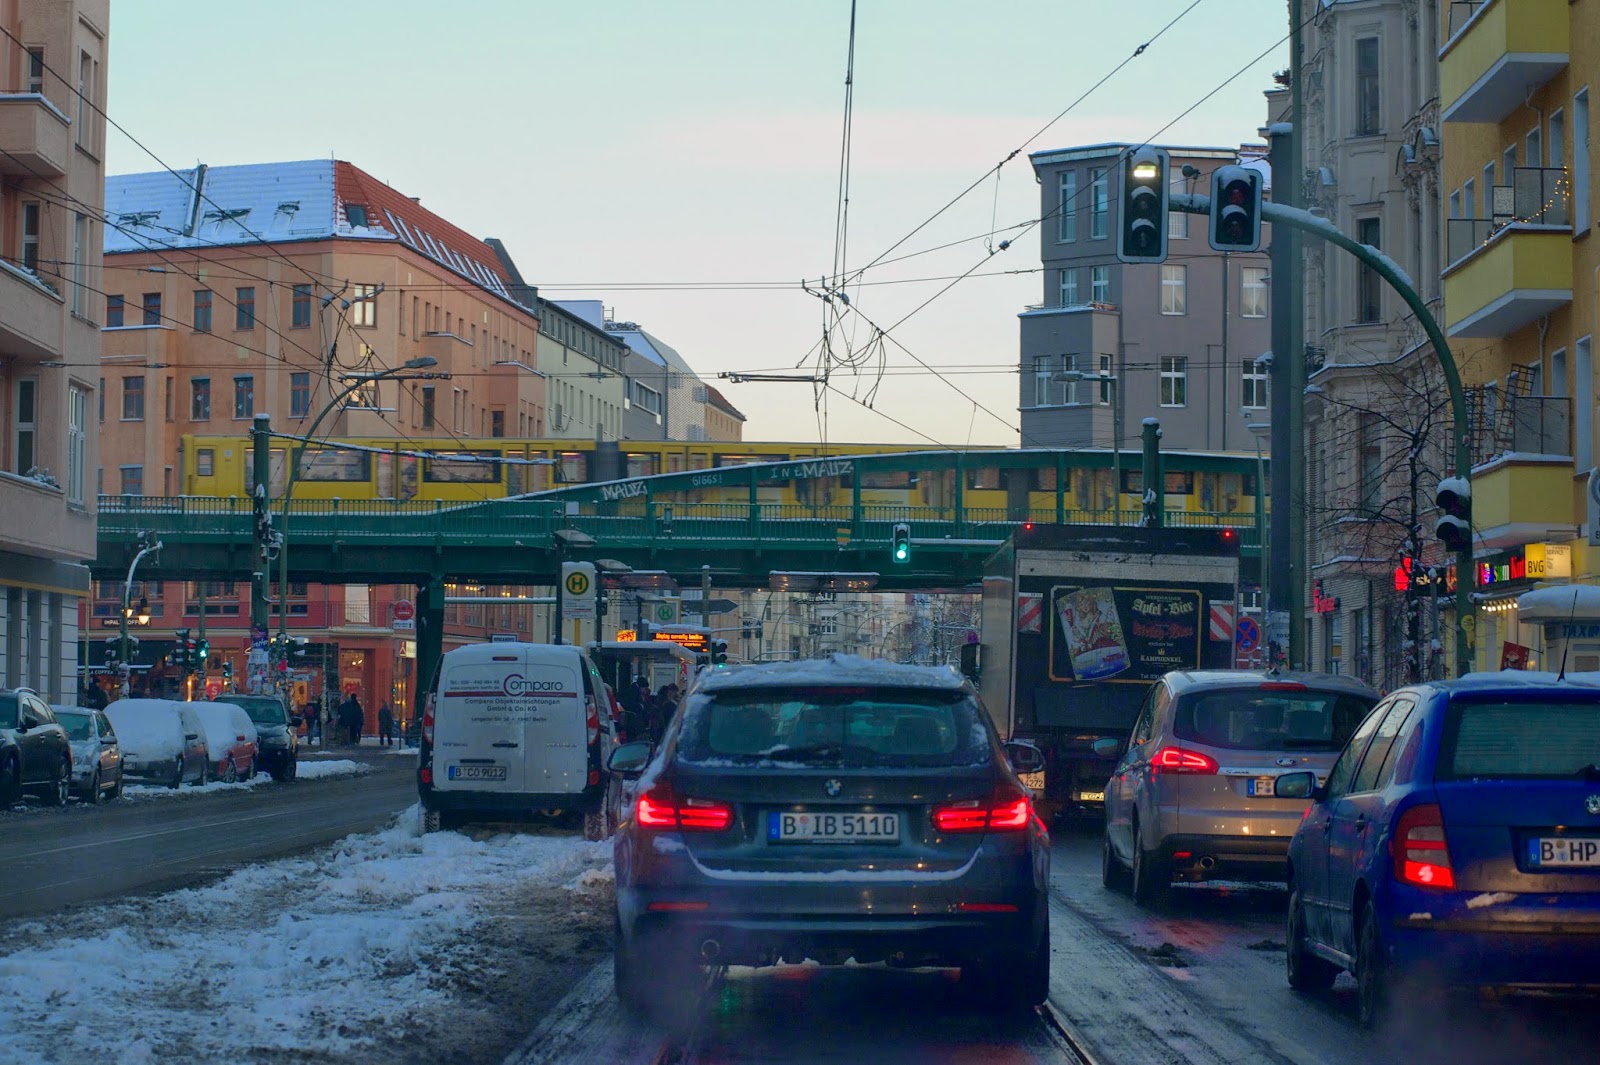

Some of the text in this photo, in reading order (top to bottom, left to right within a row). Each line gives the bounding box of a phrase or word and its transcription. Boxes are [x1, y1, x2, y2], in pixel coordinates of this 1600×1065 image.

[1527, 560, 1544, 573] BVG
[503, 673, 563, 697] Comparo
[455, 767, 462, 777] B
[481, 766, 505, 777] 9012
[783, 816, 895, 836] B IB 5110
[1541, 842, 1597, 861] B HP
